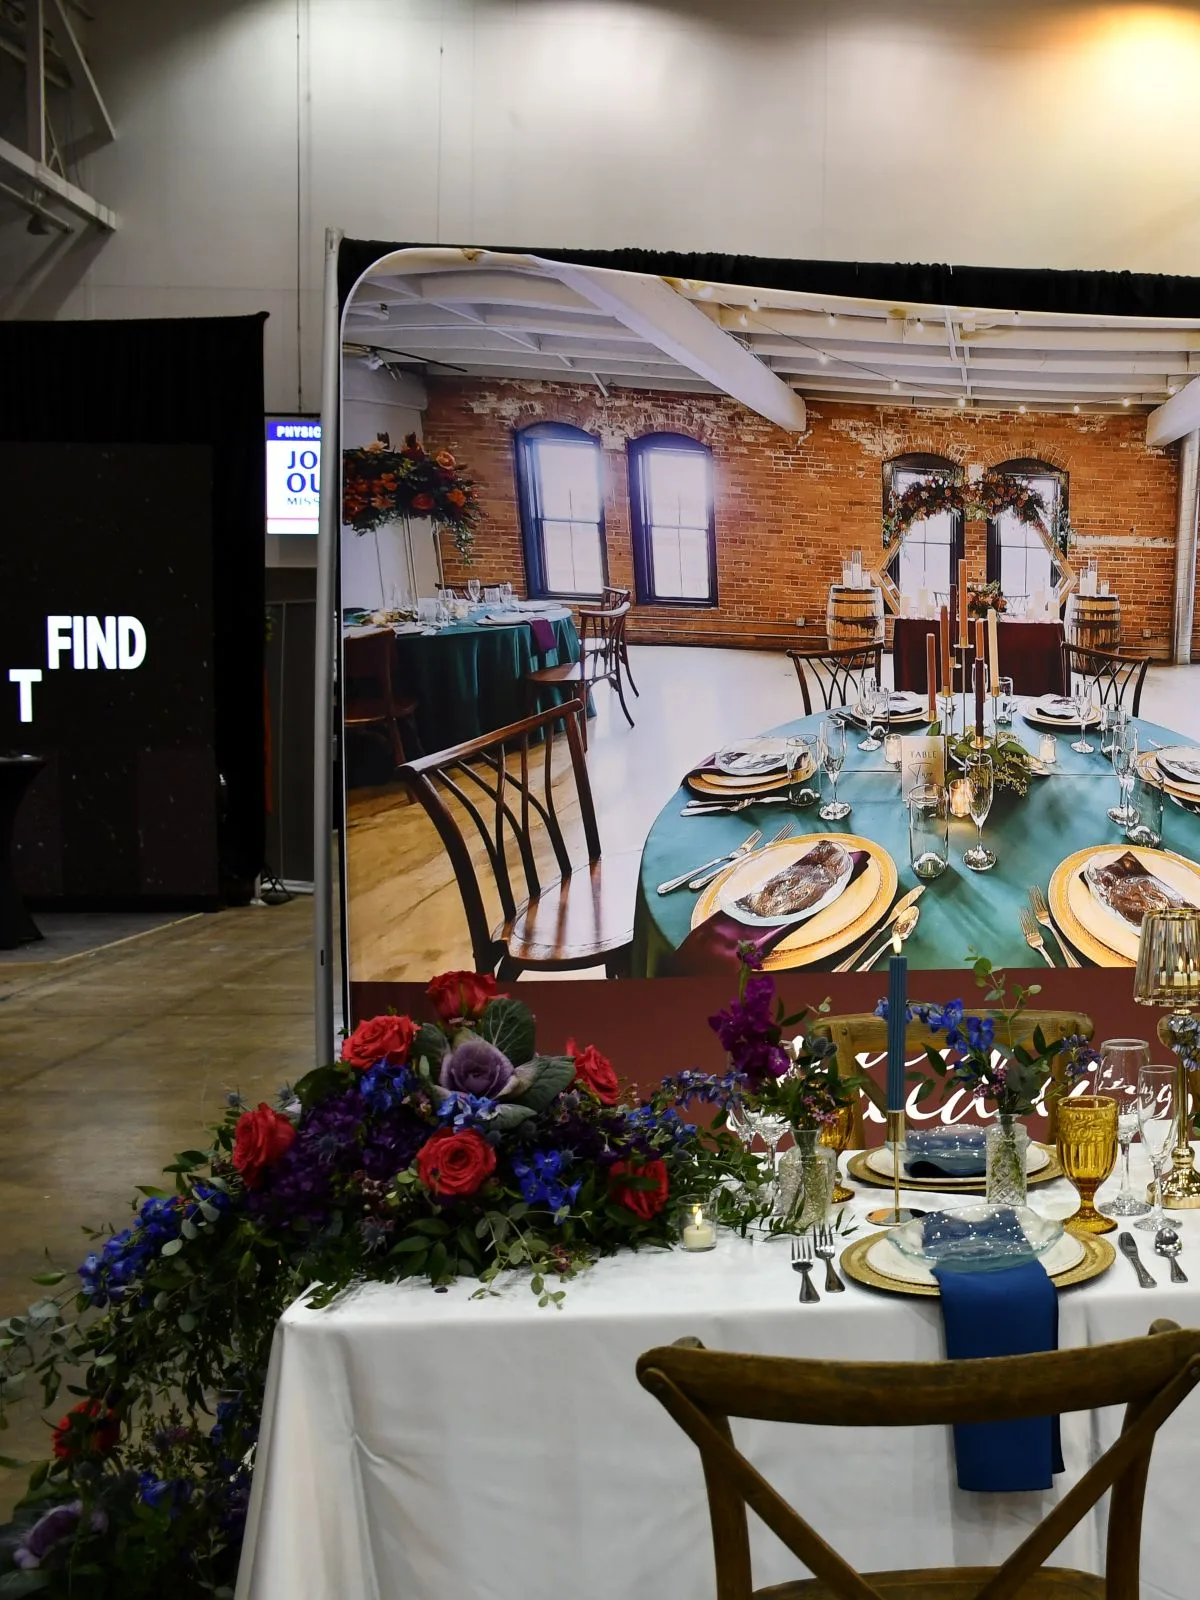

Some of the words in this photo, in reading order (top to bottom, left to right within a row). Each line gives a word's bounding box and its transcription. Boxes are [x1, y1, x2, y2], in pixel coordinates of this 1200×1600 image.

[276, 425, 321, 439] PHYSIC
[286, 450, 318, 470] JO
[286, 472, 321, 493] OU
[47, 616, 147, 670] FIND
[9, 668, 42, 722] T
[909, 750, 937, 759] TABLE
